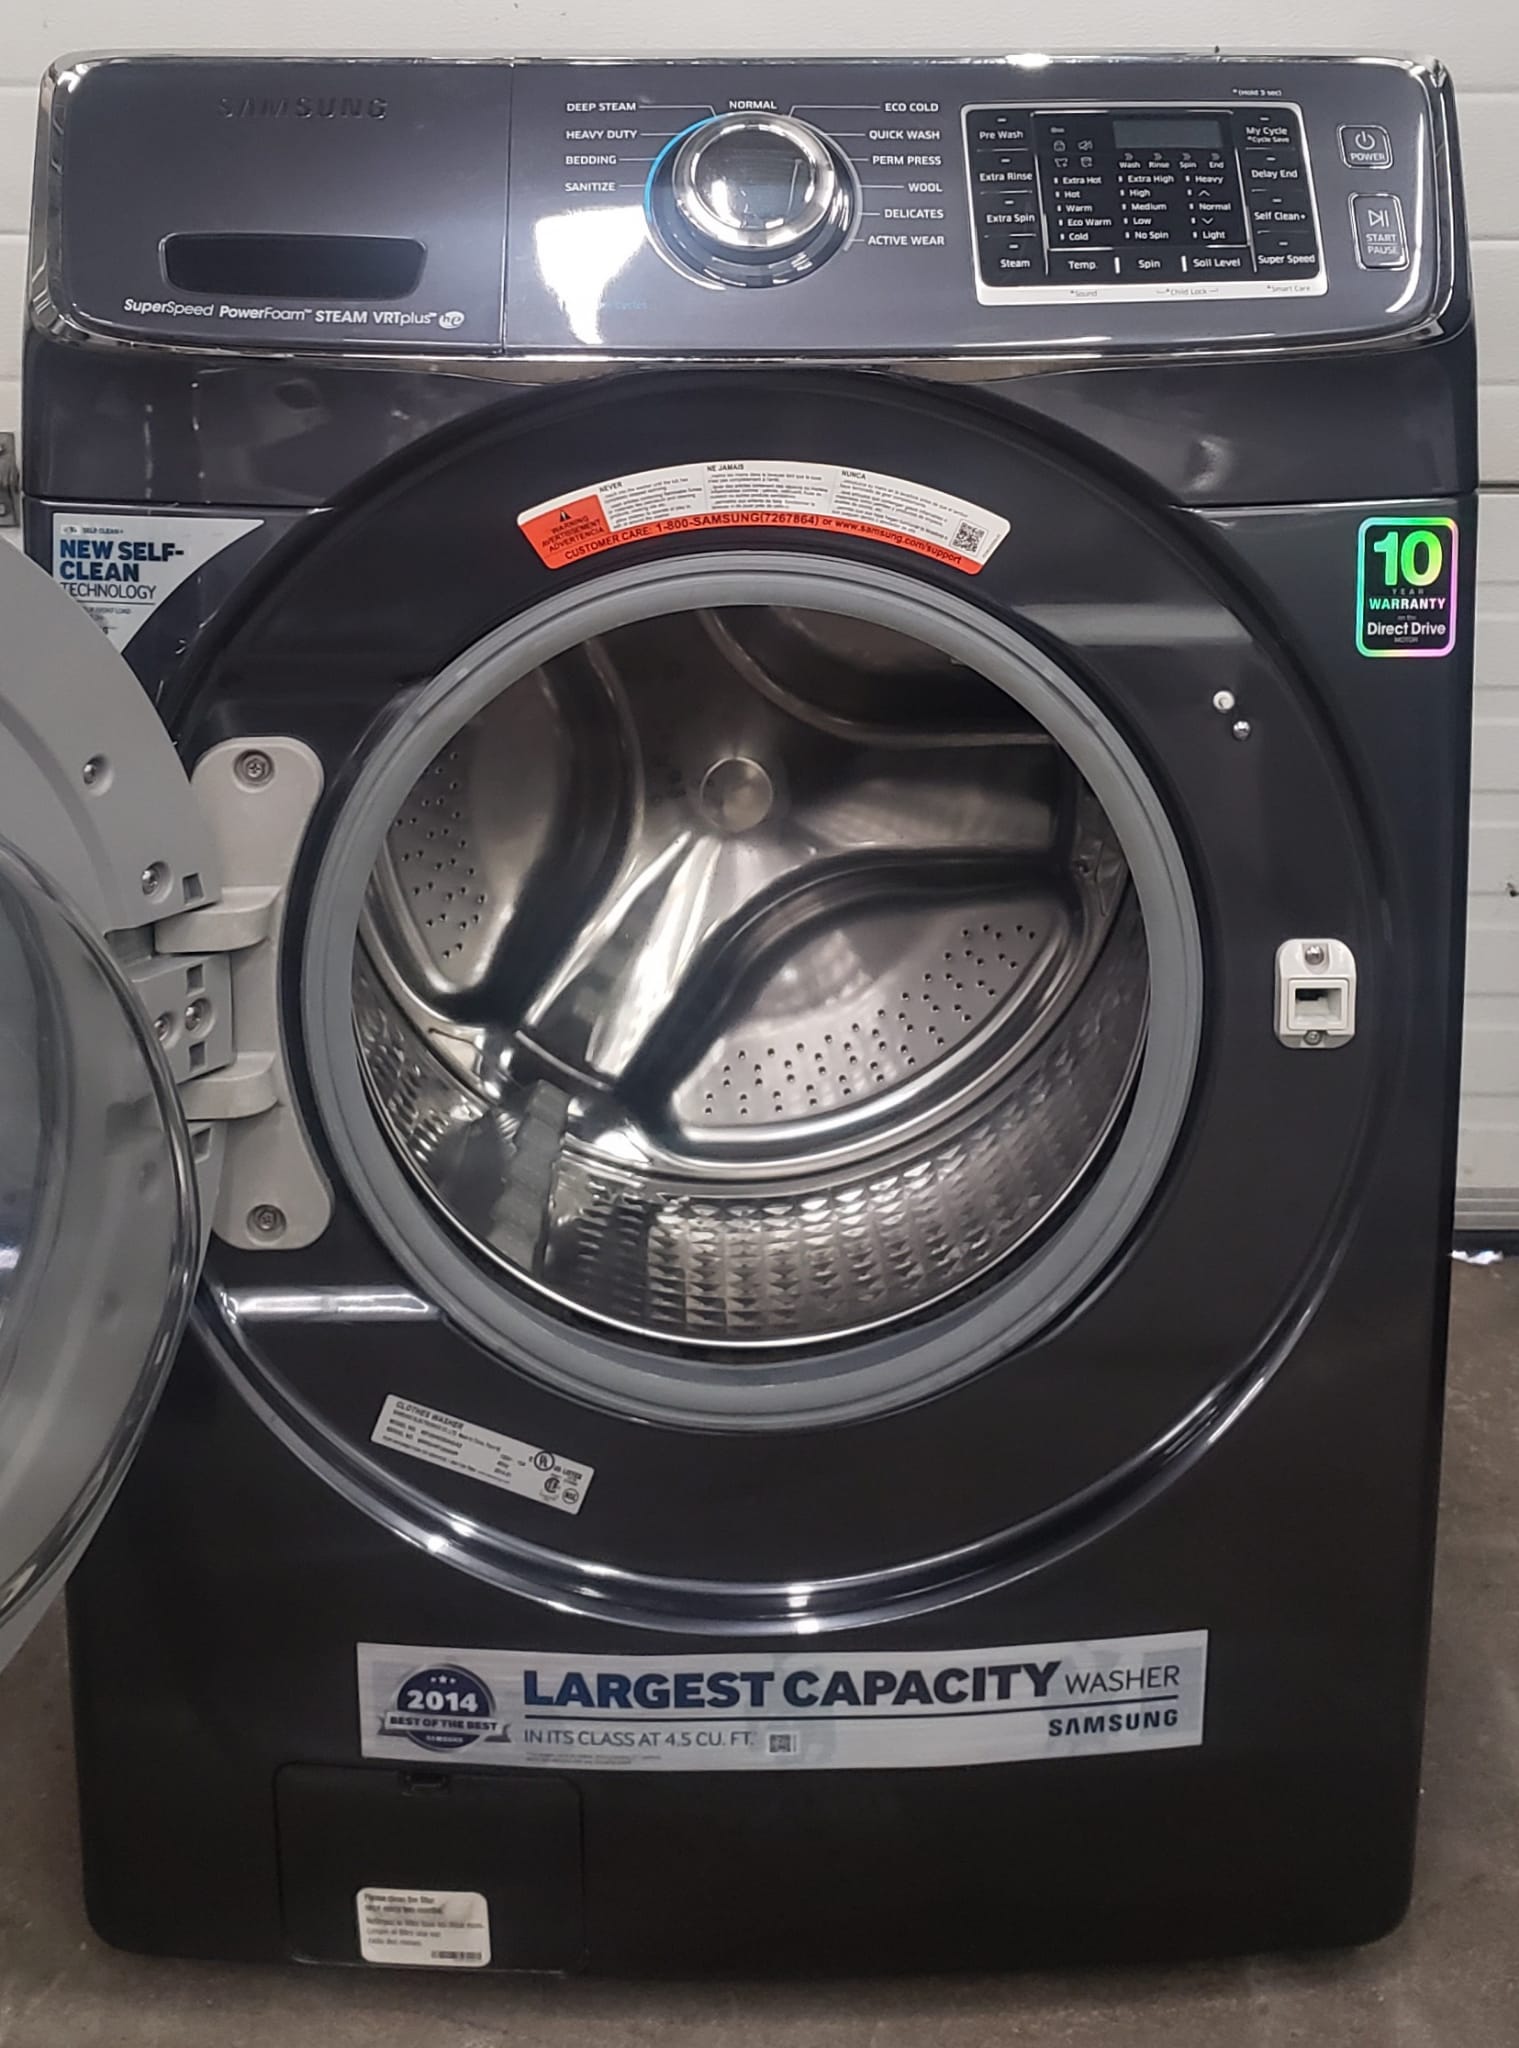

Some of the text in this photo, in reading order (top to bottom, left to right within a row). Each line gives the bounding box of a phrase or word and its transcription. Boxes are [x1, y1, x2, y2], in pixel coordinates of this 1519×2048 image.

[219, 97, 388, 119] SAMSUNG
[566, 102, 636, 112] DEEP STEAM
[729, 101, 777, 110] NORMAL
[885, 102, 939, 112] ECO COLD
[566, 130, 638, 140] HEAVY DUTY
[869, 130, 940, 140] QUICK WASH
[980, 131, 1023, 139] Pre Wash
[1246, 127, 1287, 136] My Cycle
[565, 155, 617, 165] BEDDING
[872, 155, 942, 165] PERM PRESS
[1350, 153, 1385, 161] POWER
[980, 172, 1032, 181] Extra Rinse
[1128, 175, 1174, 183] Extra High
[1251, 170, 1298, 179] Delay End
[1195, 176, 1224, 184] Heavy
[565, 182, 616, 192] SANITIZE
[908, 182, 943, 192] WOOL
[1129, 189, 1151, 198] High
[884, 209, 944, 219] DELICATES
[986, 214, 1035, 223] Extra Spin
[1254, 212, 1272, 220] Self
[868, 235, 945, 245] ACTIVE WEAR
[1149, 231, 1169, 240] Spin
[1202, 231, 1226, 240] Light
[1366, 234, 1396, 242] START
[1368, 246, 1398, 254] PAUSE
[1000, 259, 1030, 268] Steam
[1138, 260, 1160, 269] Spin
[1192, 258, 1240, 267] Soil Level
[1258, 255, 1315, 264] Super Speed
[124, 298, 215, 320] SuperSpeed
[314, 310, 368, 325] STEAM
[841, 470, 866, 480] NUNCA
[599, 482, 623, 493] NEVER
[551, 515, 589, 534] WARNING
[564, 534, 620, 560] CUSTOMER
[822, 518, 833, 526] or
[835, 519, 963, 565] www.samsung.com/support
[60, 539, 185, 562] NEW SELF-
[1374, 530, 1443, 586] 10
[60, 561, 139, 582] CLEAN
[60, 582, 157, 600] TECHNOLOGY
[1368, 598, 1446, 610] WARRANTY
[1367, 622, 1446, 635] Direct Drive
[396, 1401, 430, 1418] CLOTHES
[524, 1660, 1181, 1709] LARGEST CAPACITY WASHER
[406, 1690, 478, 1714] 2014
[390, 1716, 498, 1731] BEST OF THE BEST
[1048, 1708, 1179, 1737] SAMSUNG
[524, 1729, 756, 1747] IN ITS CLASS AT 4.5 CU. FT.
